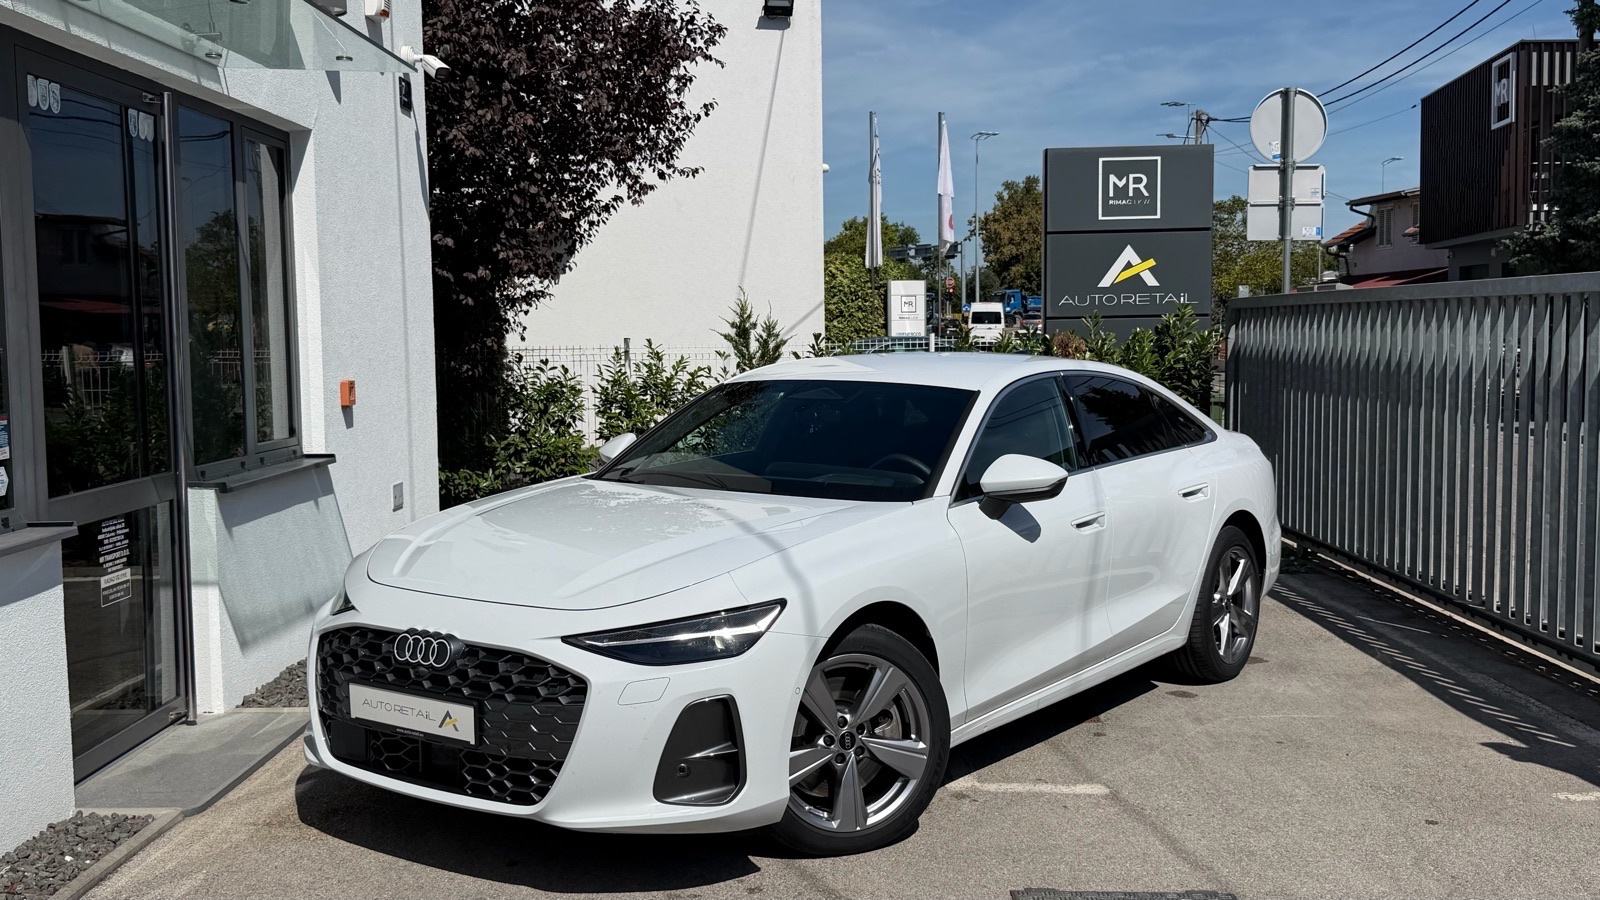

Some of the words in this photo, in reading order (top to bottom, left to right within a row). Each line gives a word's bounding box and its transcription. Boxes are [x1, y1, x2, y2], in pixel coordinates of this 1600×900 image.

[1494, 78, 1509, 107] MR
[1108, 173, 1149, 197] MR
[903, 300, 914, 308] MR
